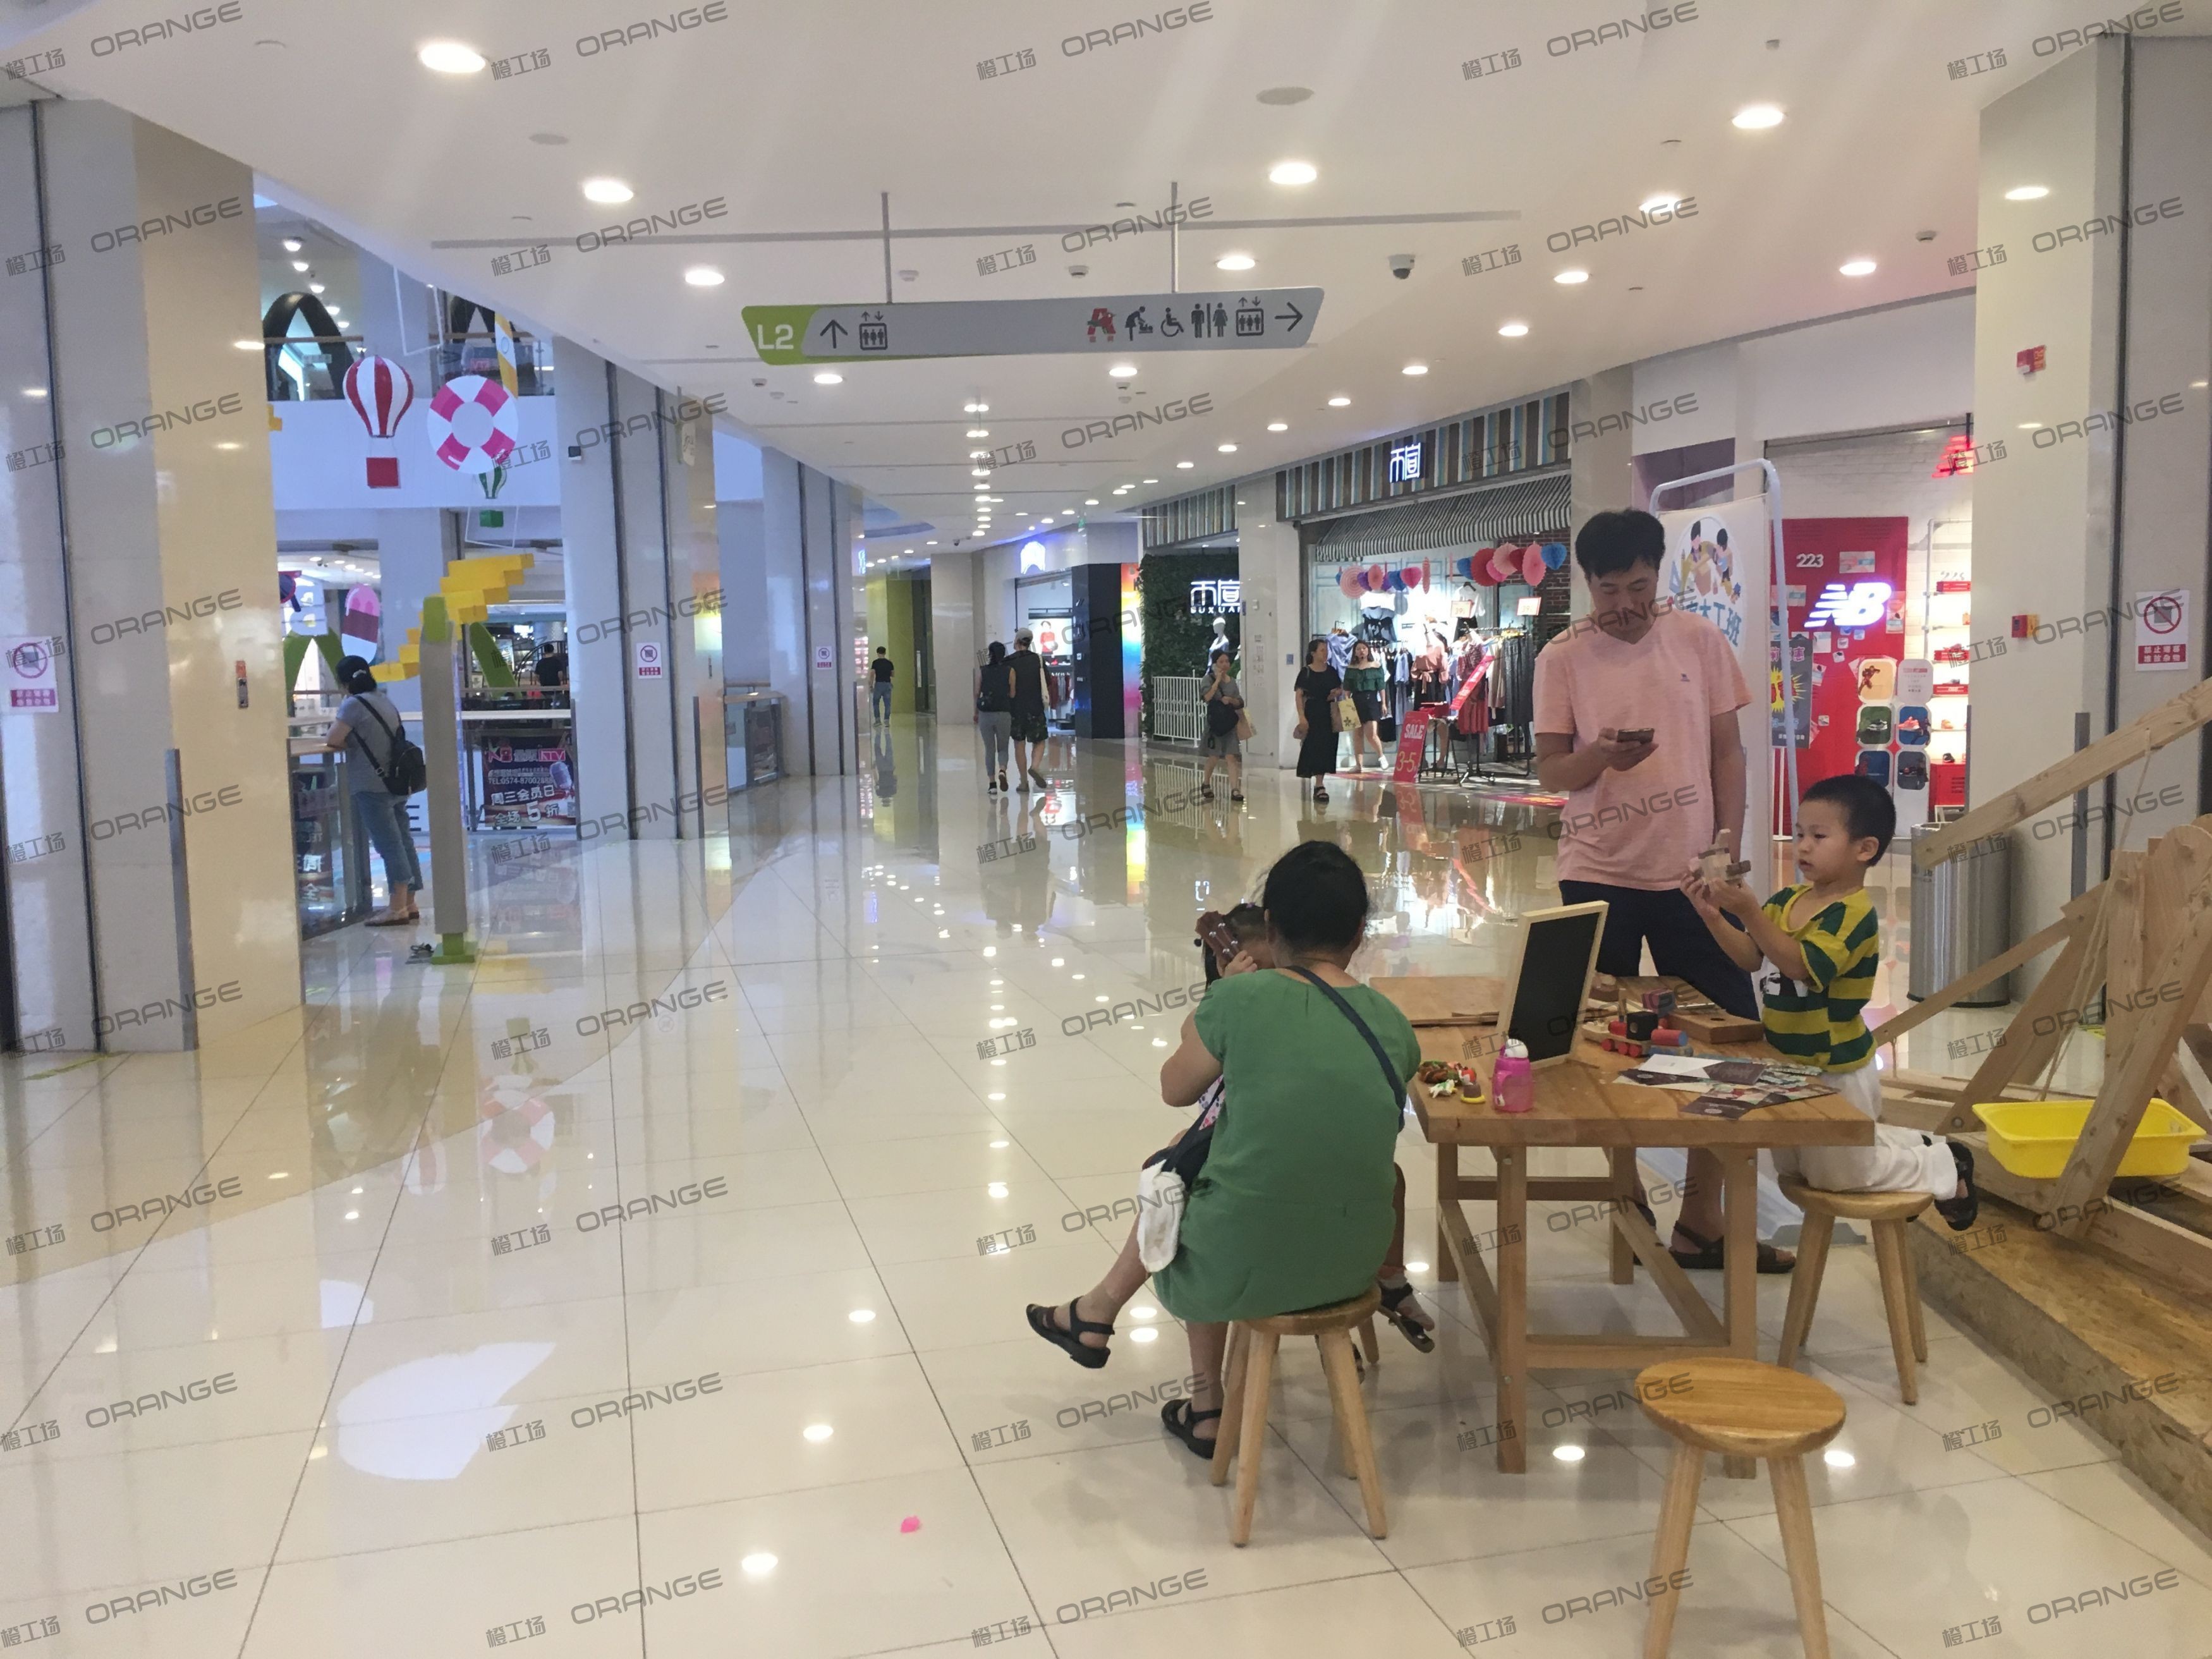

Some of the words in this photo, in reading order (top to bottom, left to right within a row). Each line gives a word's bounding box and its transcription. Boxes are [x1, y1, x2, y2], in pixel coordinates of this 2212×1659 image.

[757, 324, 794, 349] L2
[1796, 554, 1824, 568] 223
[1404, 724, 1425, 739] SALE
[491, 785, 555, 806] 周三会员日
